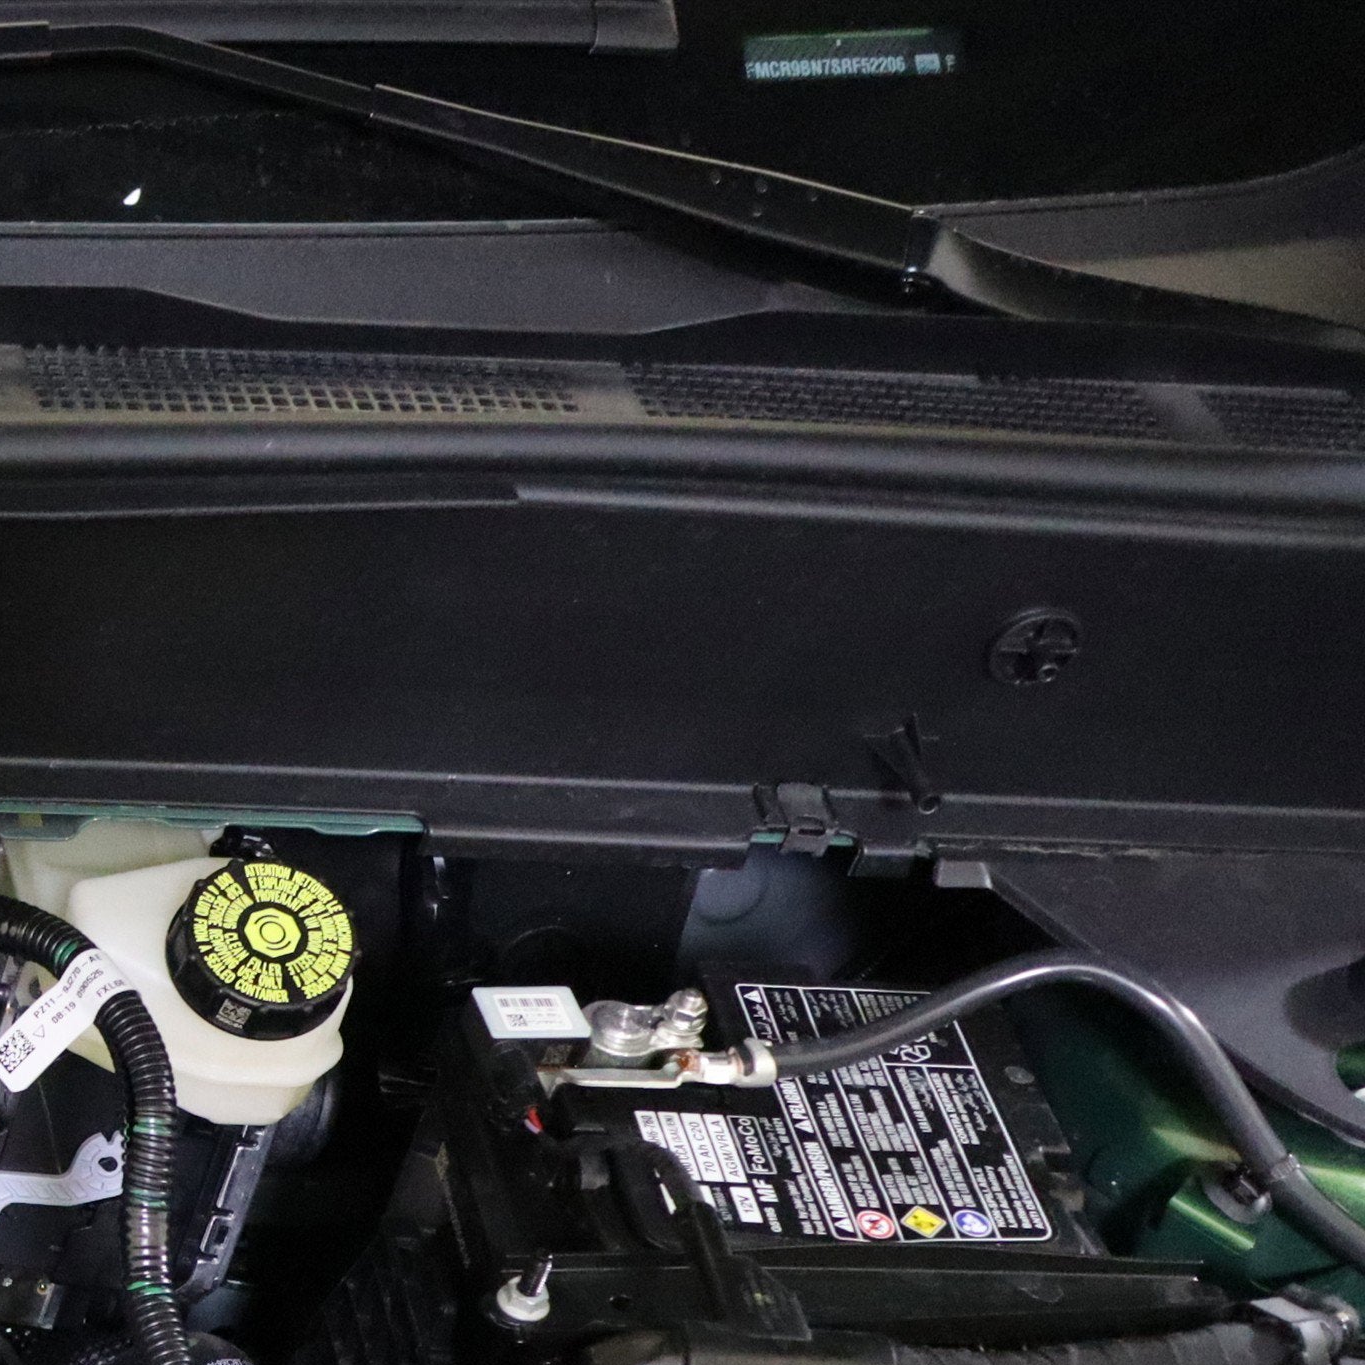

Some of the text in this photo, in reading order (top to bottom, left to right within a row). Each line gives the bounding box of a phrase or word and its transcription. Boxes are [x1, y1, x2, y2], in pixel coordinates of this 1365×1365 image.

[244, 863, 291, 881] ATTENTION
[291, 872, 333, 904] NETTOYER
[325, 900, 343, 914] LE
[195, 891, 218, 919] FLUID
[208, 894, 230, 926] BEFORE
[194, 918, 213, 943] FROM
[200, 942, 215, 951] A
[208, 929, 240, 971] REMOVING
[223, 932, 249, 961] CLEAN
[246, 957, 282, 978] FILLER
[206, 951, 239, 983] SEALED
[234, 965, 259, 984] USE
[255, 973, 286, 991] ONLY
[235, 977, 289, 1002] CONTAINER
[687, 1121, 717, 1172] 70 Ah C20
[709, 1120, 741, 1177] AGM/VRLA
[732, 1117, 770, 1171] FoMoCo
[751, 1178, 779, 1202] MF
[801, 1141, 849, 1217] DANGER/POISON
[737, 1195, 754, 1213] 12V
